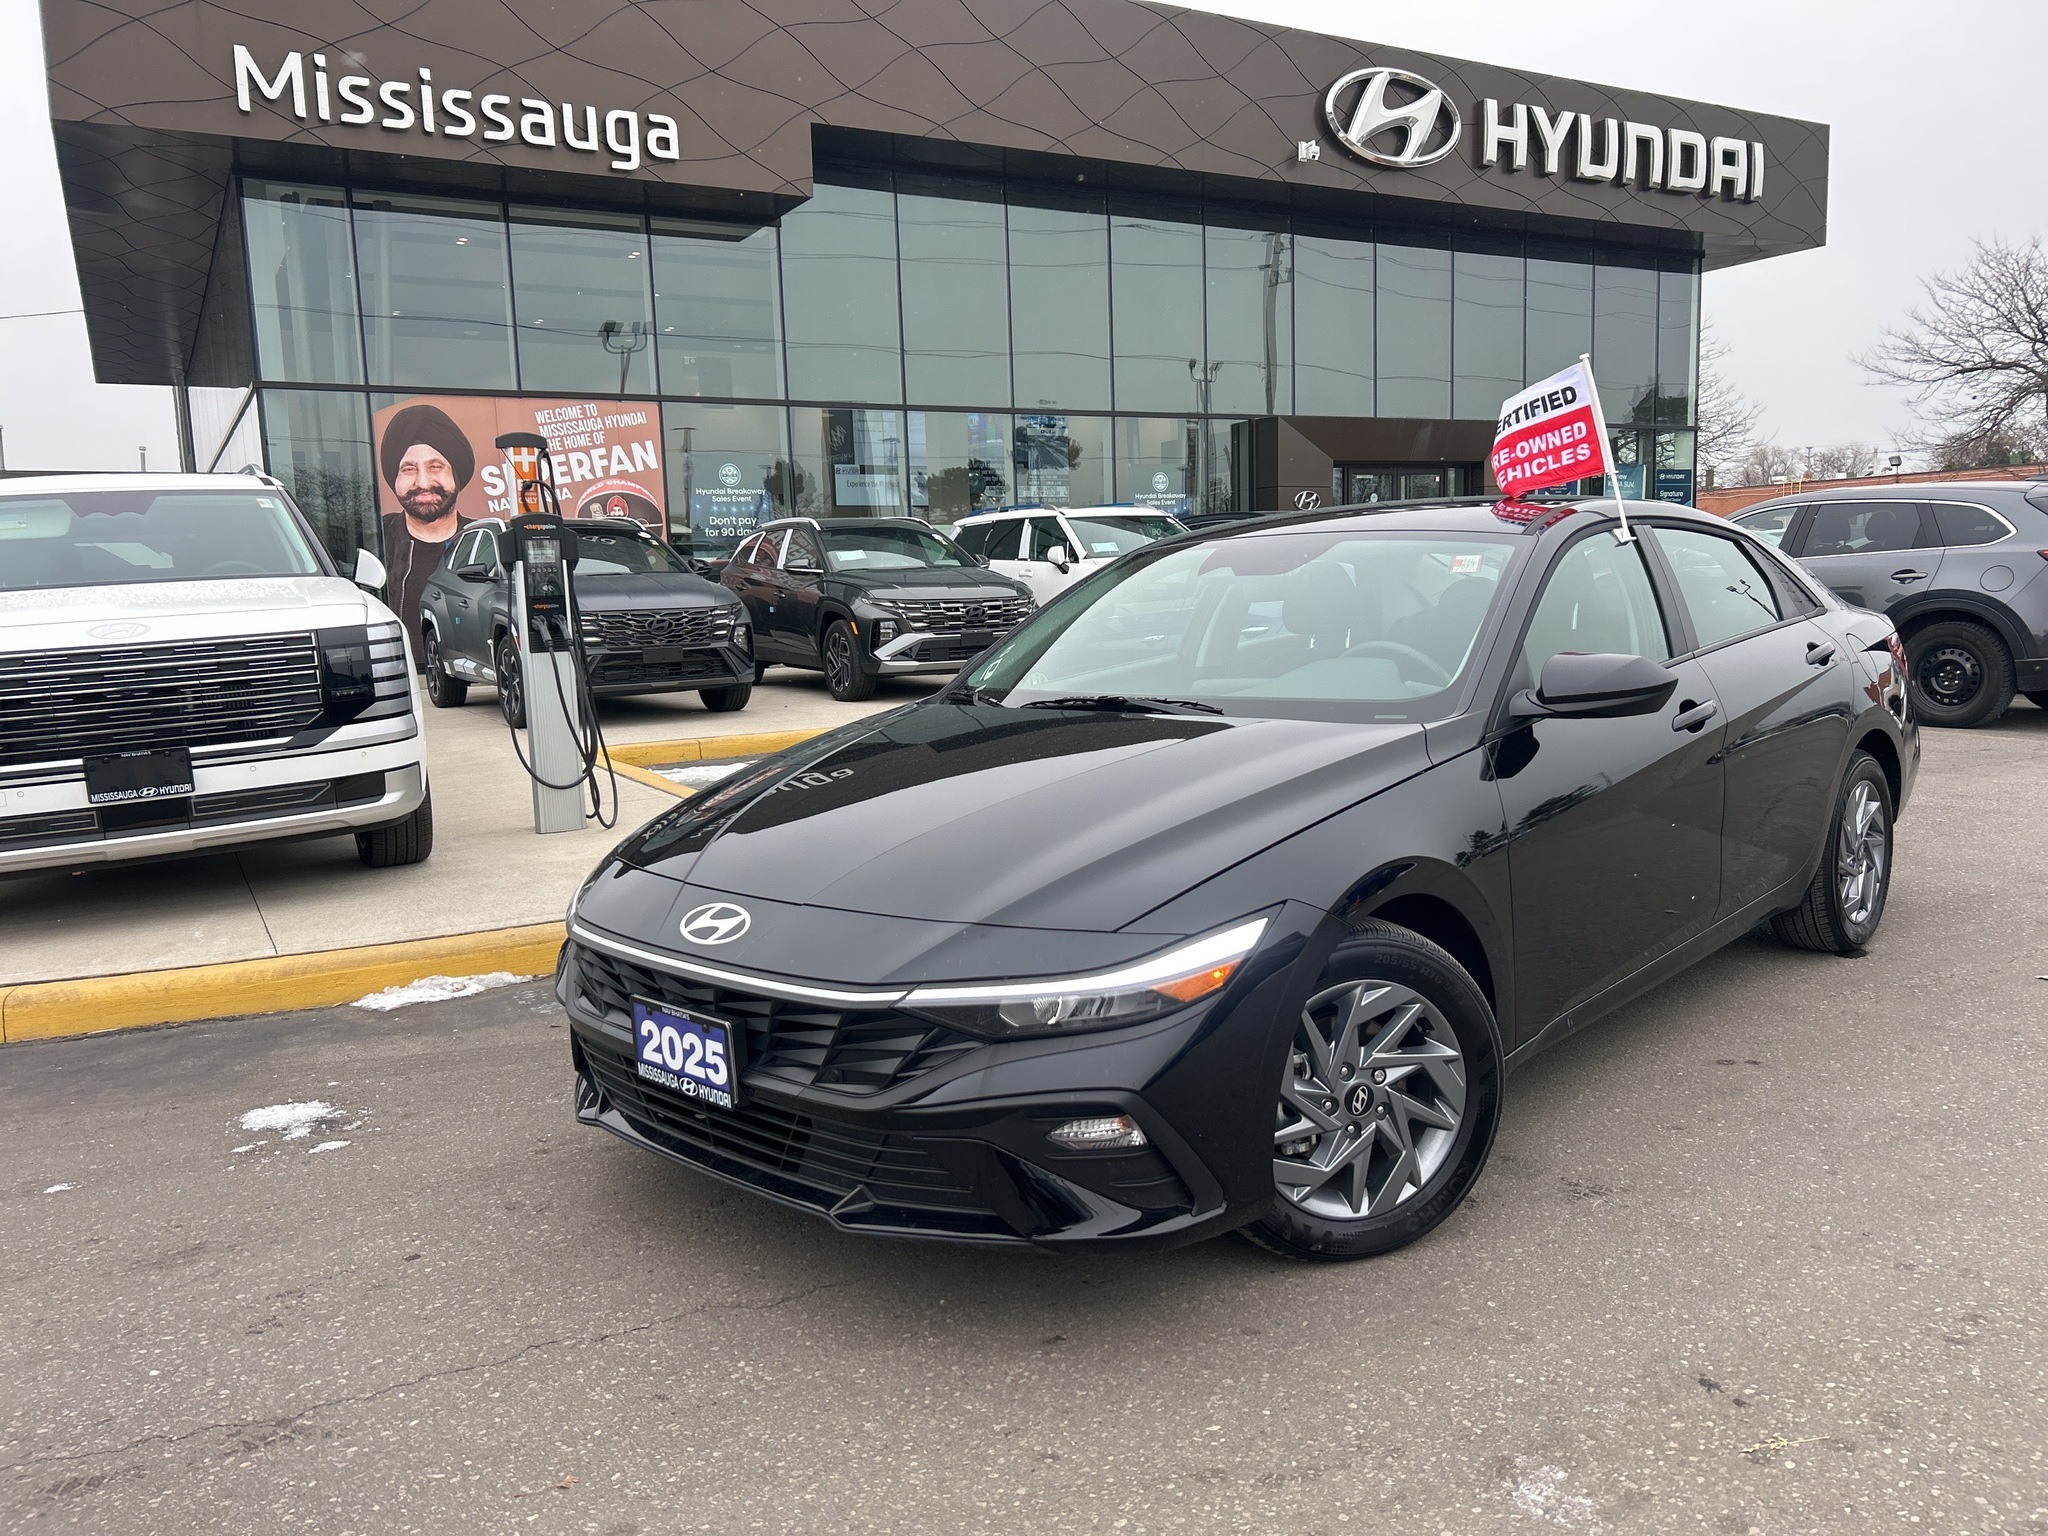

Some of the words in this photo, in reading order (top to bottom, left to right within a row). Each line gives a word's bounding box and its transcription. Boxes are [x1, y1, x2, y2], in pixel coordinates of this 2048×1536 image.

[233, 44, 679, 171] Mississauga
[1482, 98, 1764, 200] HYUNDAI
[534, 406, 584, 424] WELCOME
[584, 403, 598, 417] TO
[1496, 385, 1577, 437] ERTIFIED
[539, 417, 603, 438] MISSISSAUGA
[605, 411, 647, 429] HYUNDAI
[564, 433, 593, 449] HOME
[593, 431, 606, 445] OF
[481, 440, 658, 496] SERFAN
[696, 488, 726, 496] Hyundai
[727, 488, 766, 496] Breakaway
[1660, 490, 1684, 498] Signature
[487, 496, 511, 513] NA
[705, 528, 720, 537] for
[721, 528, 735, 537] 90
[709, 516, 737, 525] Don't
[738, 518, 757, 526] pay
[91, 790, 138, 803] MISSISSAUGA
[159, 783, 192, 795] HYUNDAI
[641, 1019, 728, 1085] 2025
[638, 1062, 680, 1090] MISSISSAUGA
[699, 1083, 732, 1109] HYUNDAI
[1406, 1160, 1475, 1232] KUMHO
